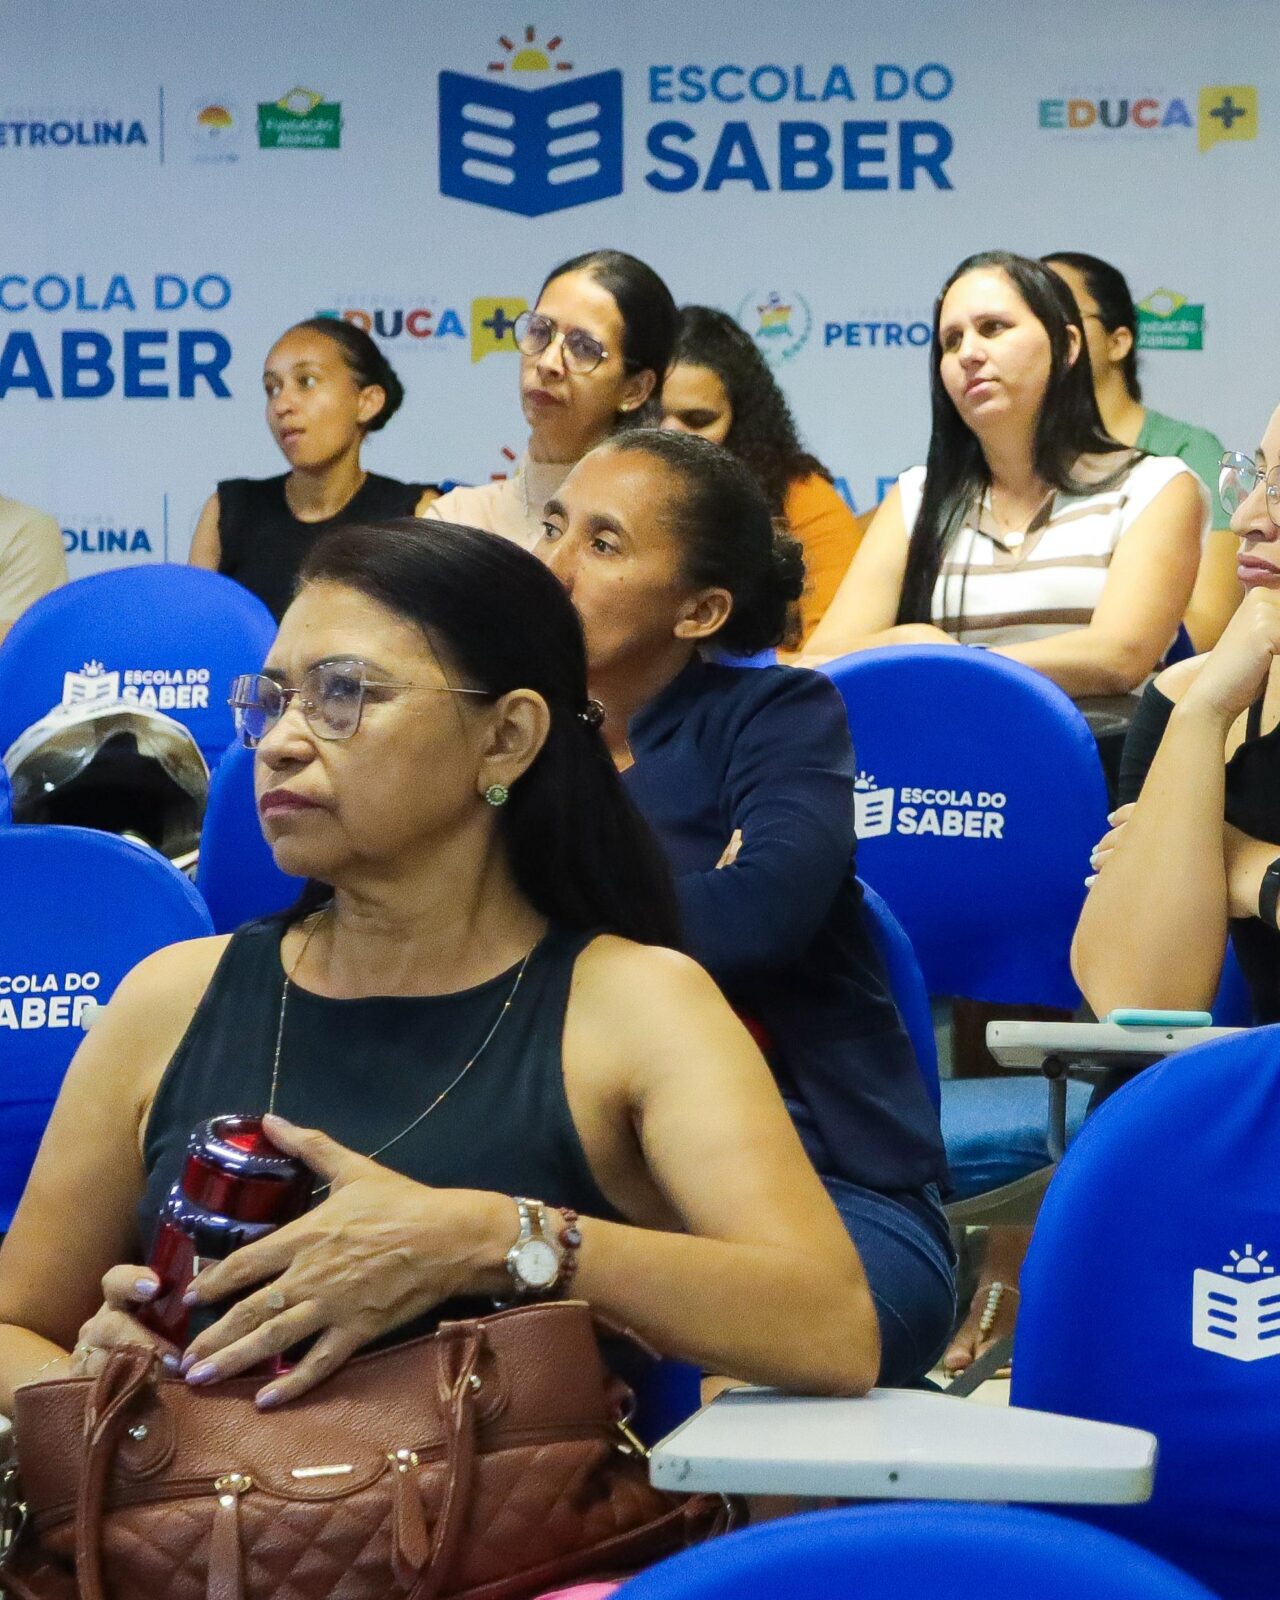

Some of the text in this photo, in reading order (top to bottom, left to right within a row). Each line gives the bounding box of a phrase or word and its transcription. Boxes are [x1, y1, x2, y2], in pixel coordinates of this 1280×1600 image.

[648, 62, 955, 103] ESCOLA DO
[1038, 97, 1193, 129] EDUCA
[645, 120, 955, 193] SABER
[0, 273, 232, 312] COLA DO
[315, 308, 466, 338] DUCA
[824, 321, 932, 348] PETRO
[0, 330, 233, 399] ABER
[124, 668, 210, 686] ESCOLA DO
[122, 684, 209, 710] SABER
[900, 787, 1007, 809] ESCOLA DO
[896, 806, 1005, 839] SABER
[0, 971, 100, 995] COLA DO
